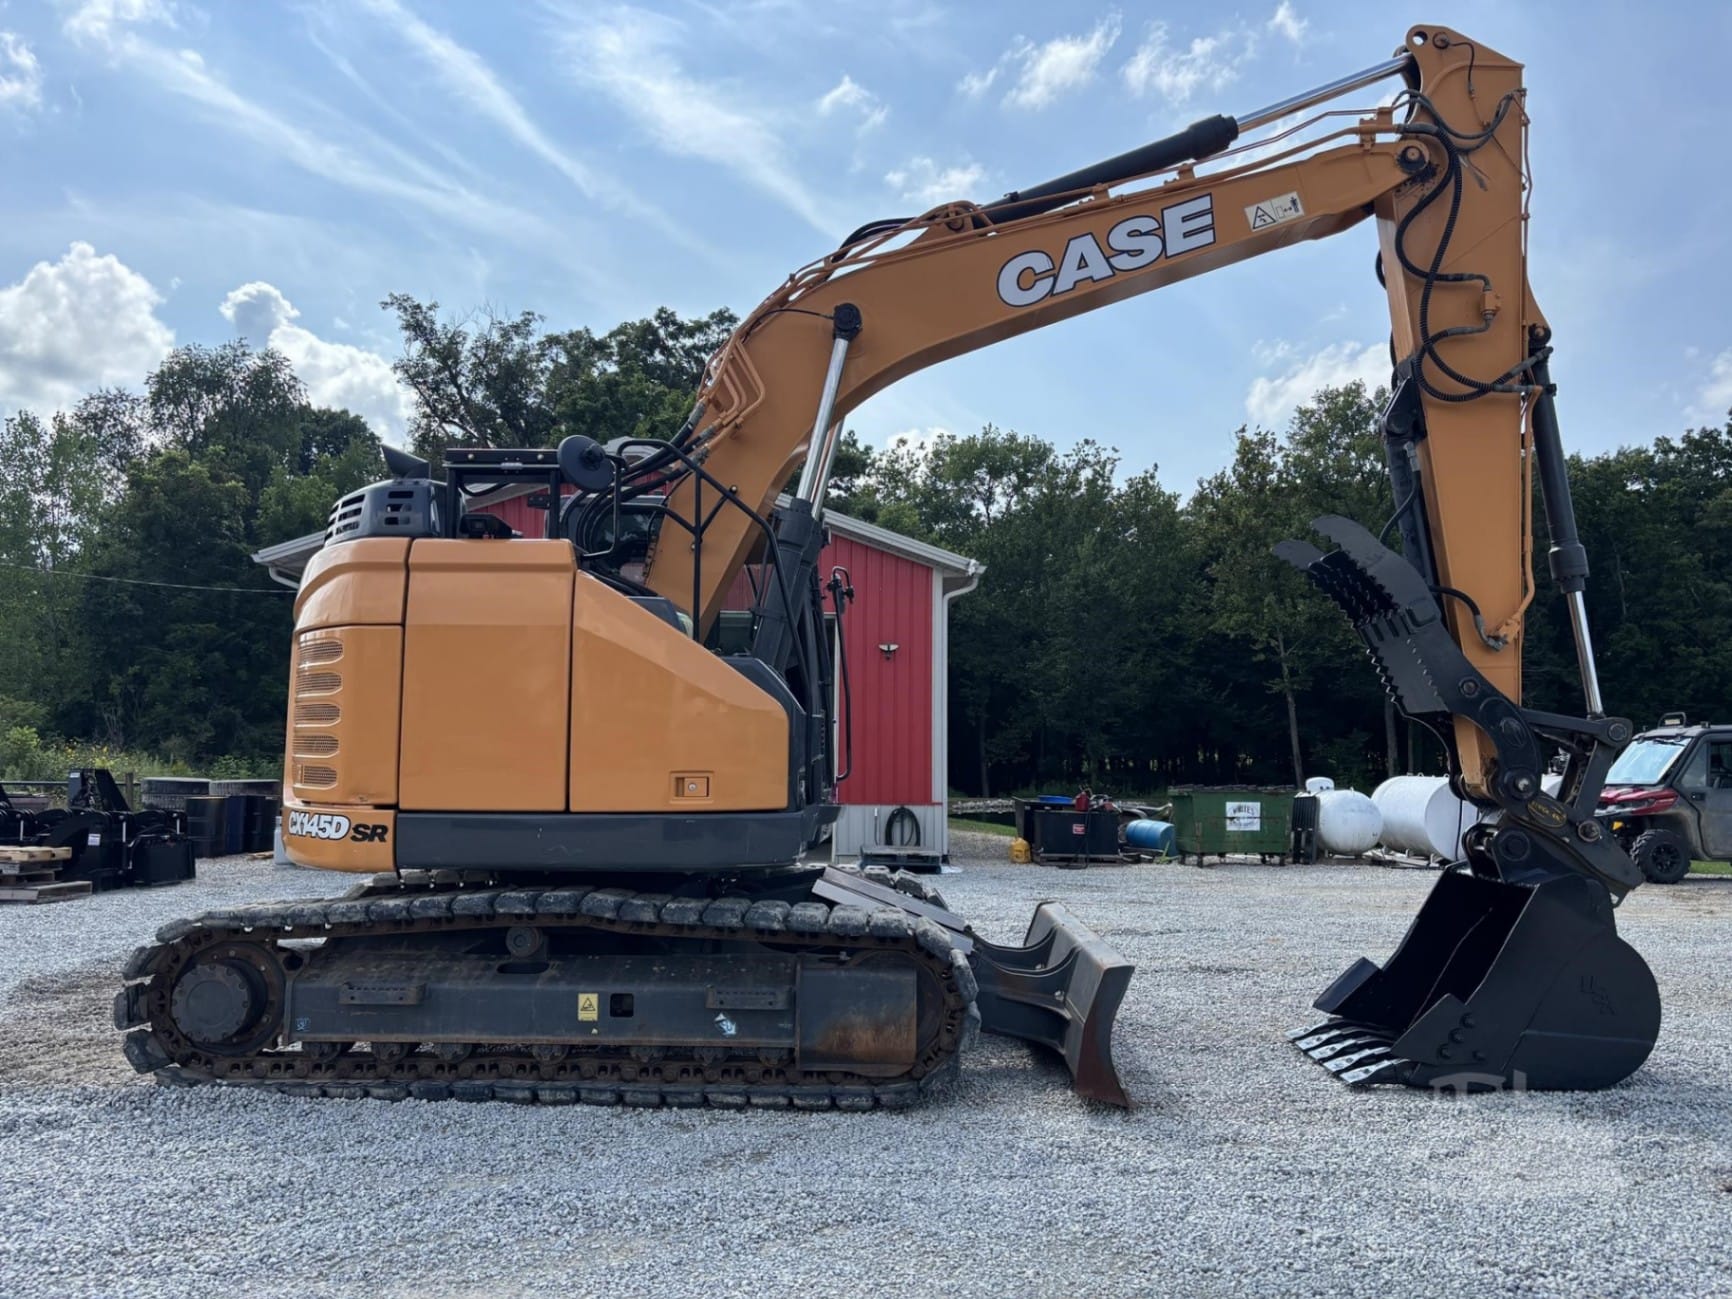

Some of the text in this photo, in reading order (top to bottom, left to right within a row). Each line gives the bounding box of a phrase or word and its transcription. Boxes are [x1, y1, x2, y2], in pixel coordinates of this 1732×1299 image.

[997, 193, 1216, 307] CASE
[288, 810, 388, 842] CX145D SR
